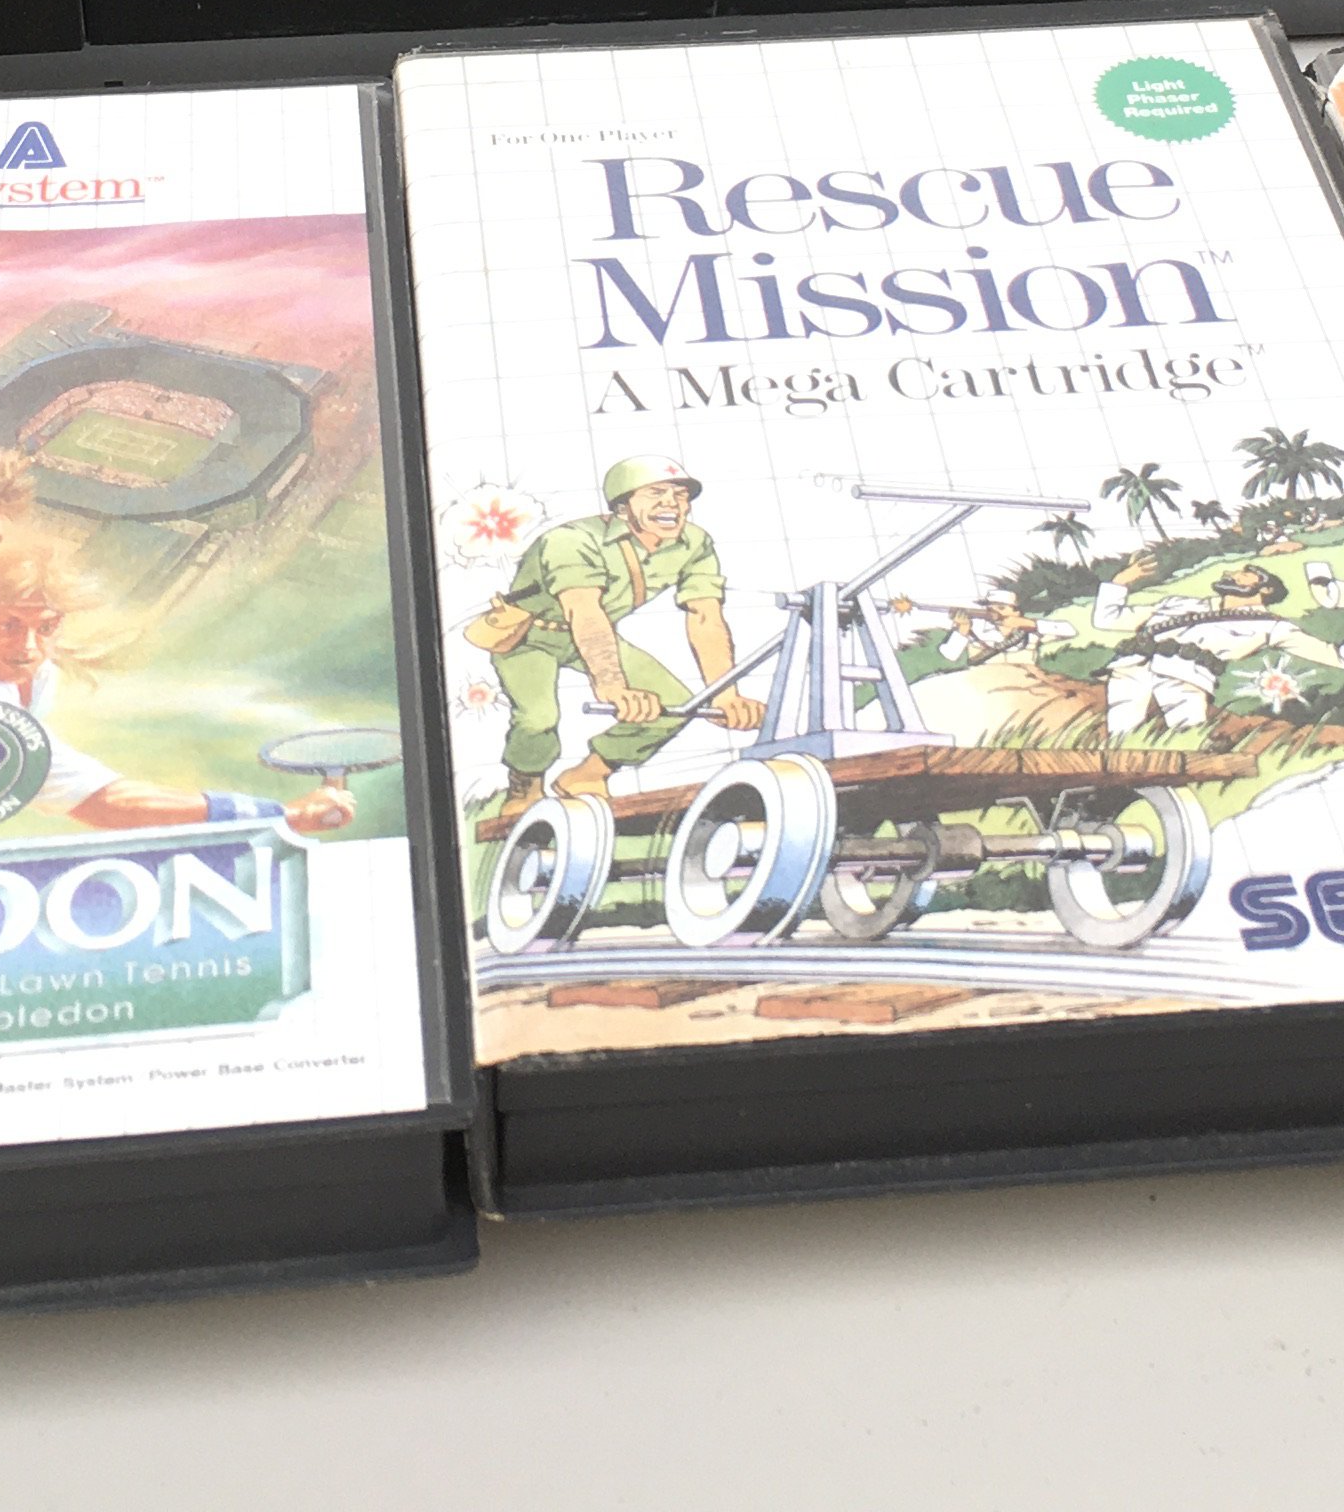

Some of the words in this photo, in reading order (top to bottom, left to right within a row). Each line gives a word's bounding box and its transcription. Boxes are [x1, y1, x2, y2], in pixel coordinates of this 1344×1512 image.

[1126, 91, 1200, 106] Phaser
[1132, 78, 1185, 95] Light
[1123, 100, 1218, 118] Required
[491, 132, 533, 146] For
[540, 130, 592, 143] One
[599, 126, 677, 144] Player
[580, 156, 1182, 242] Rescue
[571, 245, 1236, 350] Mission
[594, 370, 647, 415] A
[670, 360, 867, 417] Mega
[886, 348, 1248, 402] Cartridge
[0, 969, 104, 993] Lawn
[125, 952, 253, 984] Tennis
[63, 1072, 133, 1090] System
[218, 1063, 264, 1076] Base
